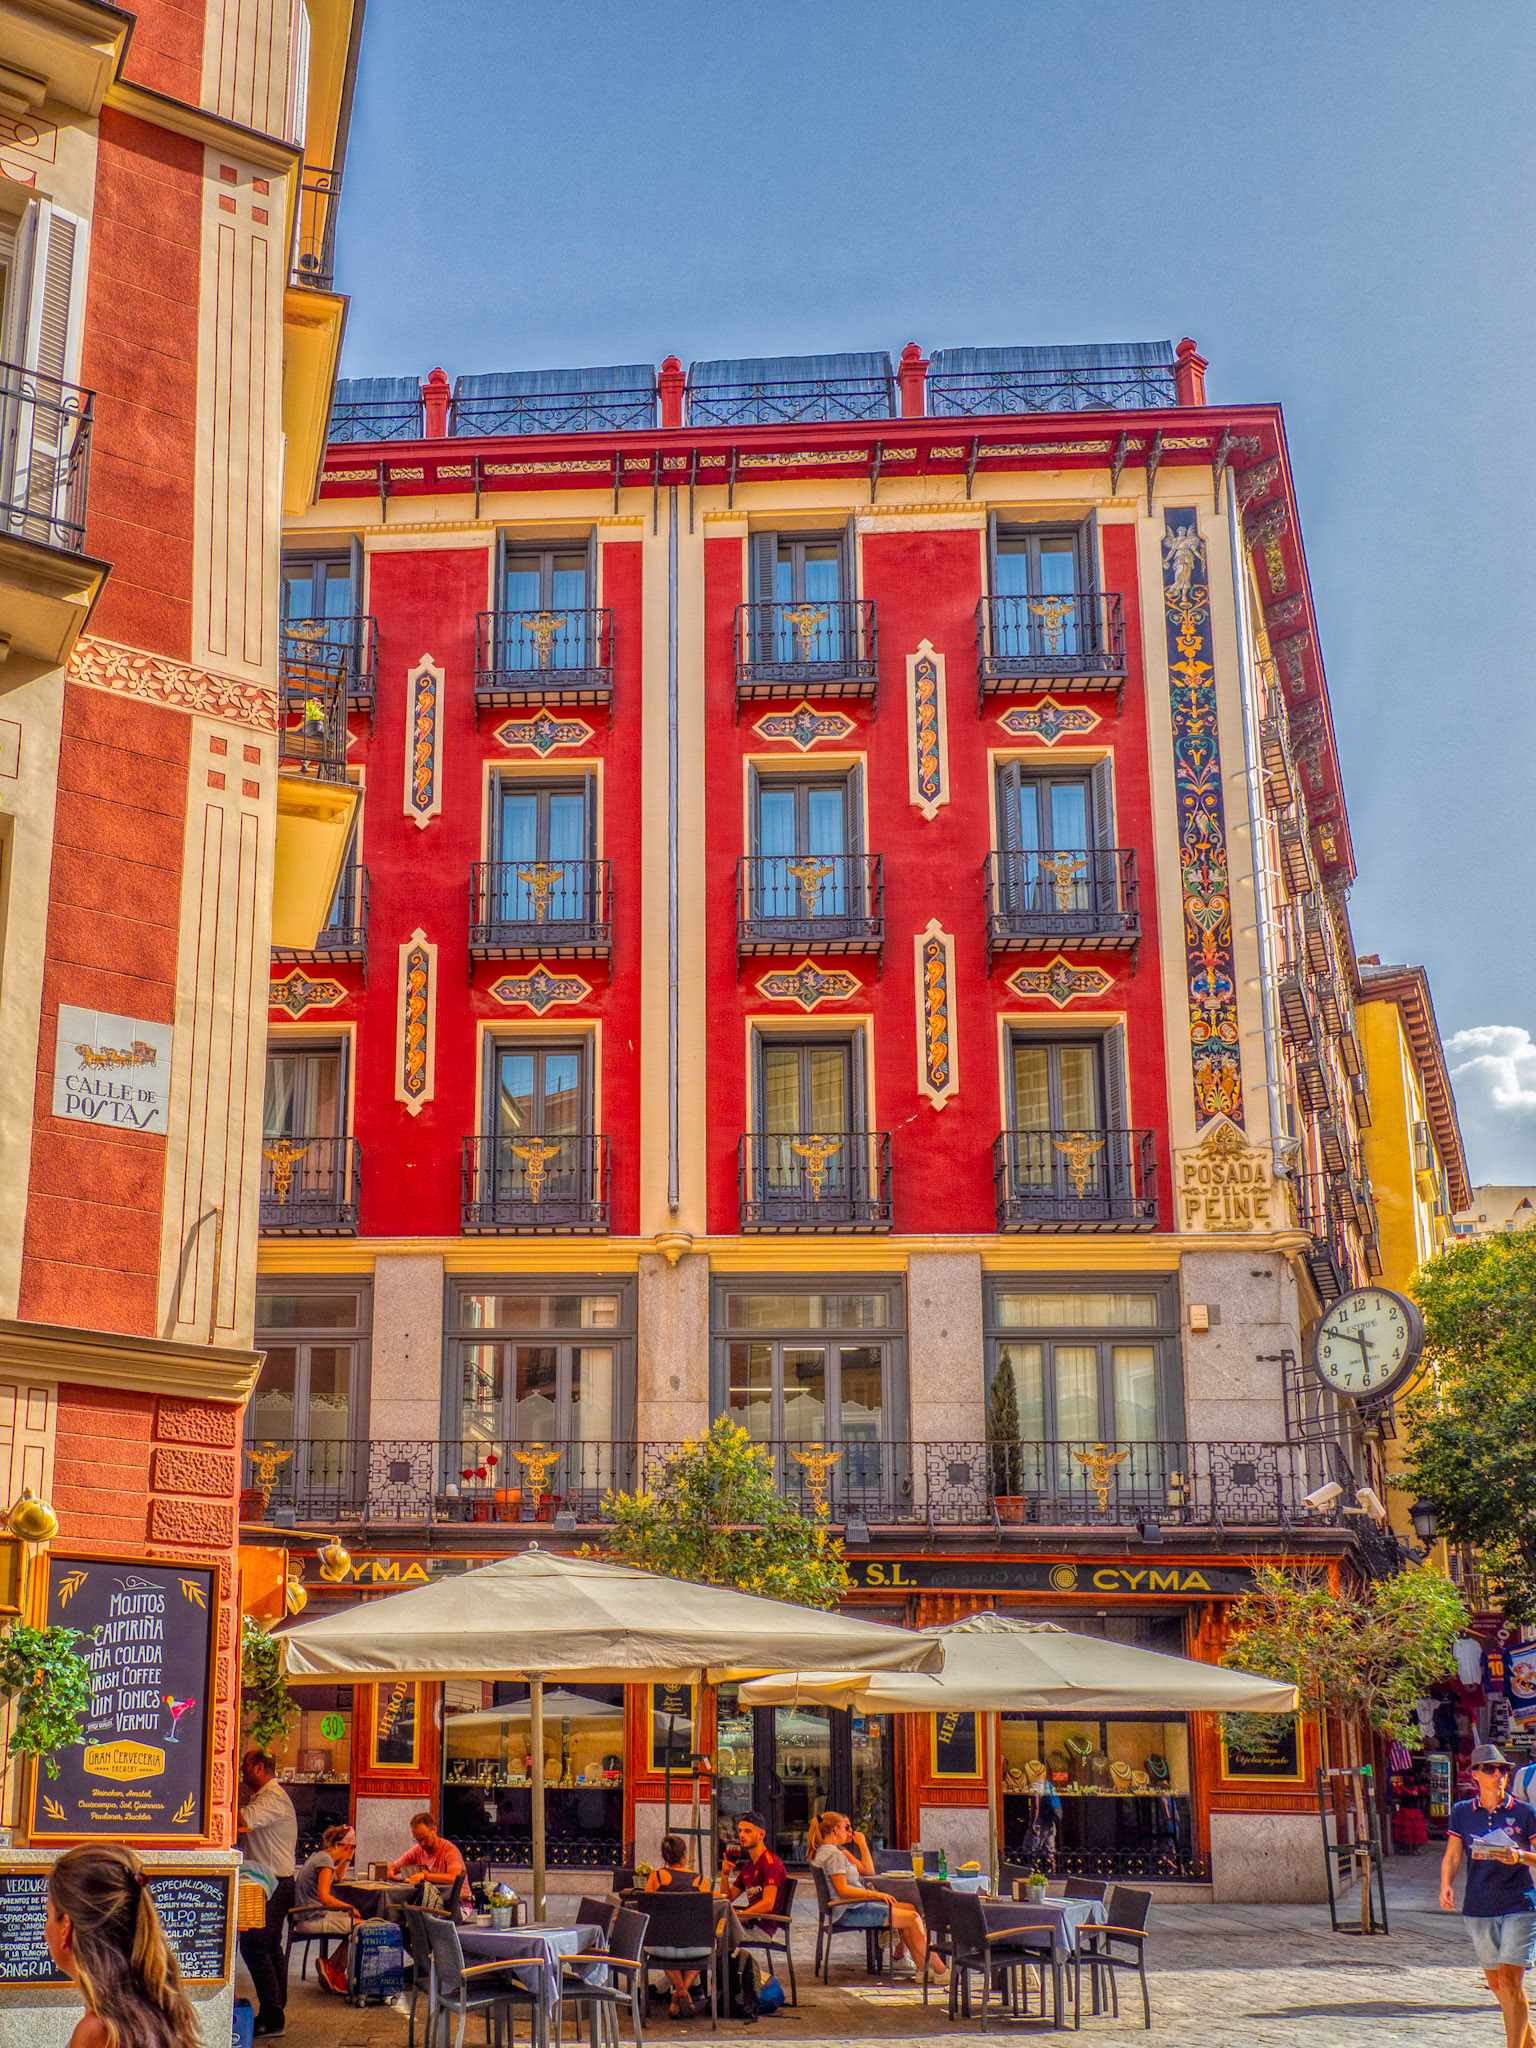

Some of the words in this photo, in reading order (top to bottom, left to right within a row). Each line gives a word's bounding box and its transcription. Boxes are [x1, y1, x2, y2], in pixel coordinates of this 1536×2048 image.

[66, 1075, 132, 1101] CALLE
[138, 1089, 157, 1104] DE
[65, 1094, 160, 1128] POSTAS
[1183, 1164, 1266, 1185] POSADA
[1211, 1186, 1240, 1196] DEL
[1186, 1197, 1269, 1220] PEINE
[1353, 1298, 1366, 1313] 12
[1375, 1298, 1382, 1311] 1
[1338, 1309, 1349, 1323] 11
[1389, 1307, 1397, 1320] 2
[1326, 1326, 1338, 1341] 10
[1396, 1326, 1405, 1339] 3
[1323, 1346, 1332, 1358] 9
[1392, 1347, 1401, 1360] 4
[1330, 1363, 1338, 1377] 8
[1380, 1363, 1389, 1377] 5
[1344, 1373, 1352, 1386] 7
[1362, 1373, 1371, 1387] 6
[865, 1563, 918, 1586] S.L.
[1093, 1569, 1212, 1592] CYMA
[109, 1592, 165, 1617] MOJITOS
[94, 1615, 164, 1647] CAIPIRIÑA
[115, 1645, 163, 1666] COLADA
[1488, 1661, 1504, 1676] 10
[91, 1670, 119, 1693] IRISH
[122, 1666, 162, 1685] COFFEE
[117, 1688, 160, 1711] TONICS
[116, 1713, 159, 1732] VERMUT
[88, 1750, 111, 1765] GRAN
[113, 1749, 160, 1767] CERVECERIA
[150, 1879, 224, 1901] ESPECIALIDADES
[158, 1893, 175, 1902] DEL
[178, 1892, 201, 1903] MAR
[8, 1923, 20, 1932] CON
[0, 1942, 30, 1951] ERDURAS
[31, 1942, 49, 1950] FRES
[12, 1950, 20, 1958] LA
[0, 1960, 52, 1978] SANGRIA
